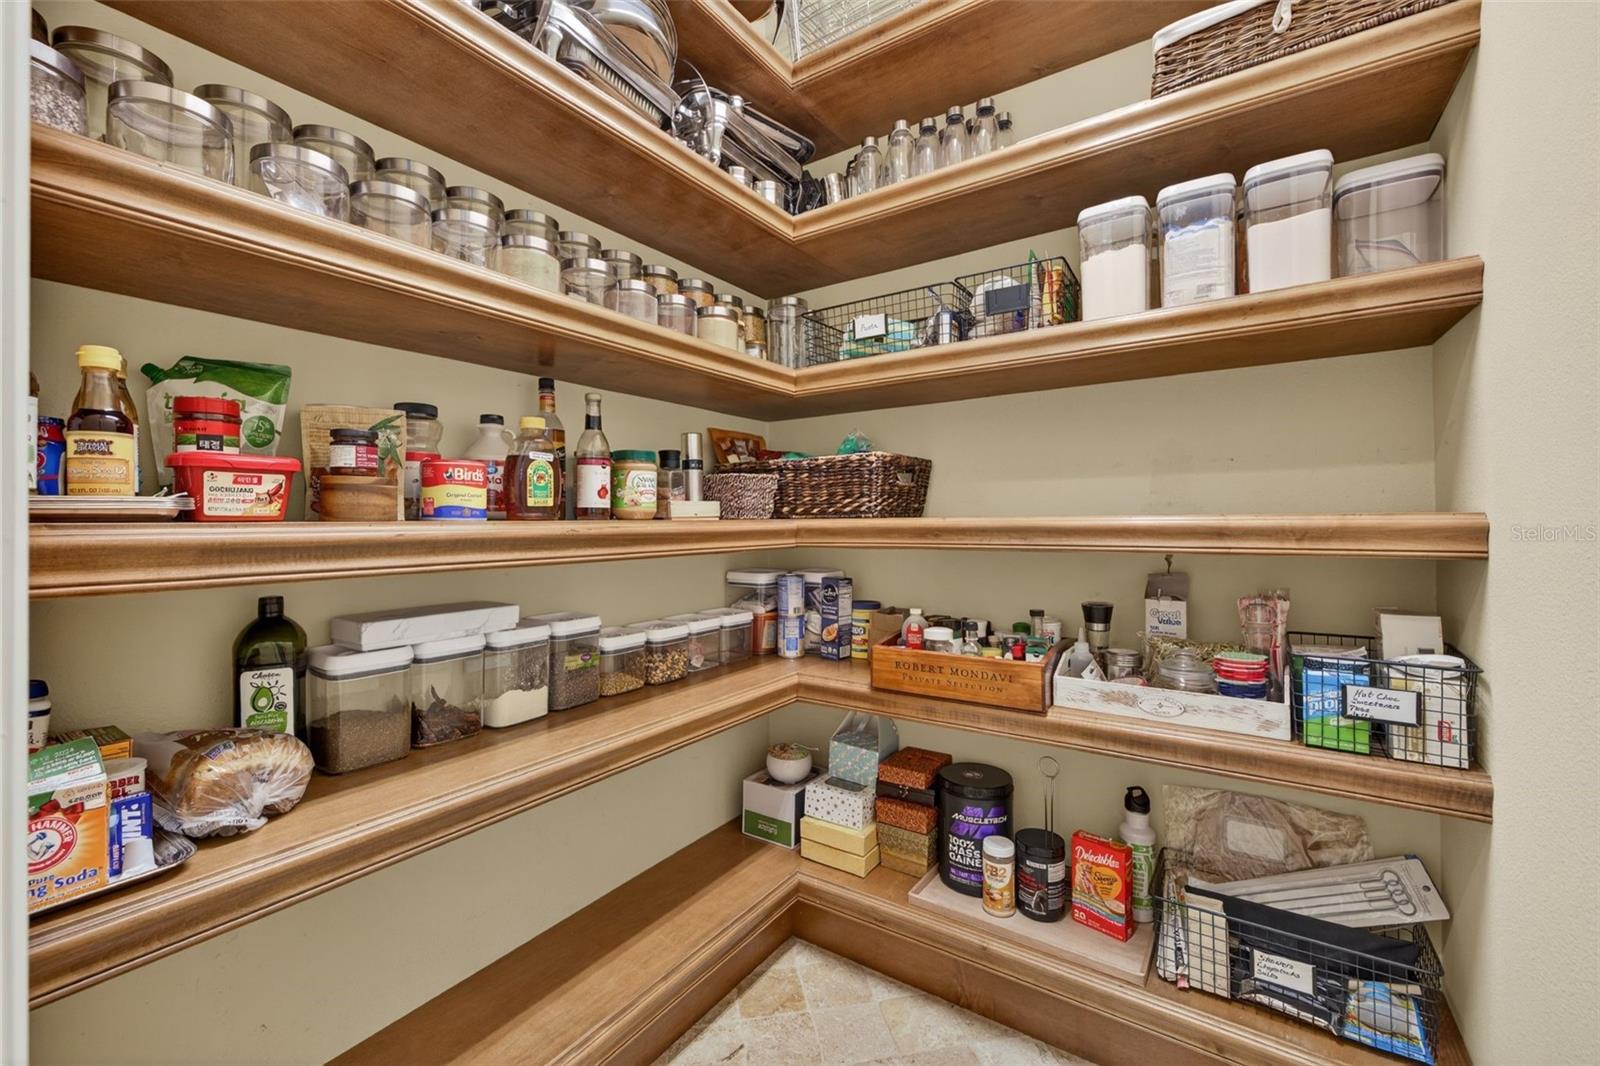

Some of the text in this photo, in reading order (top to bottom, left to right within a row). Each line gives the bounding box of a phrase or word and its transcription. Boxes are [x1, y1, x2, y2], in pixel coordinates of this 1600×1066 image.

[895, 661, 1015, 684] ROBERT MONDAVI
[902, 673, 942, 685] PRIVATE
[1354, 689, 1374, 698] Hot
[31, 820, 73, 843] HAMMER
[948, 834, 975, 850] 100%
[948, 852, 982, 867] GAINE
[949, 844, 981, 859] MASS
[1075, 845, 1120, 869] Delectables
[54, 868, 97, 889] Soda
